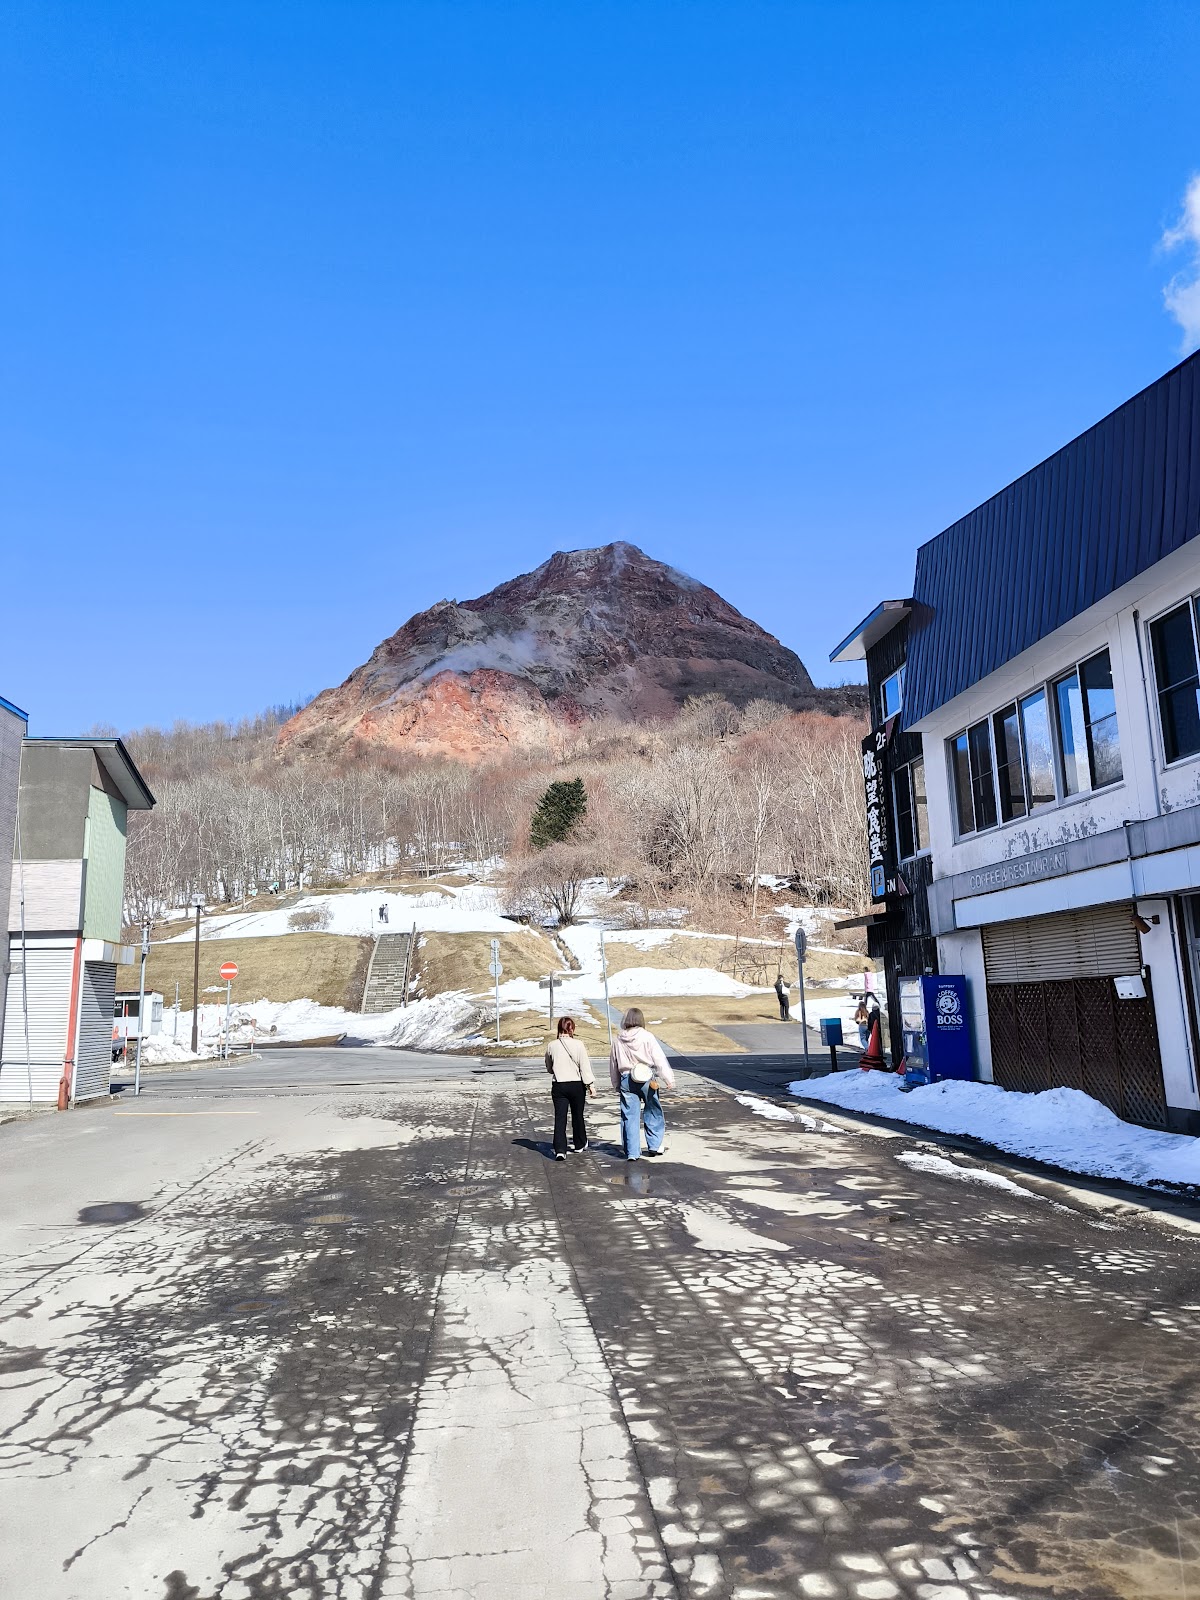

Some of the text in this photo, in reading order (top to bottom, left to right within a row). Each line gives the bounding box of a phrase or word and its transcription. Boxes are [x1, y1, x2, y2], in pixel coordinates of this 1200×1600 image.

[875, 732, 887, 751] 2F
[863, 750, 883, 866] 眺望食堂
[937, 990, 958, 998] COFFEE
[936, 1015, 963, 1025] BOSS
